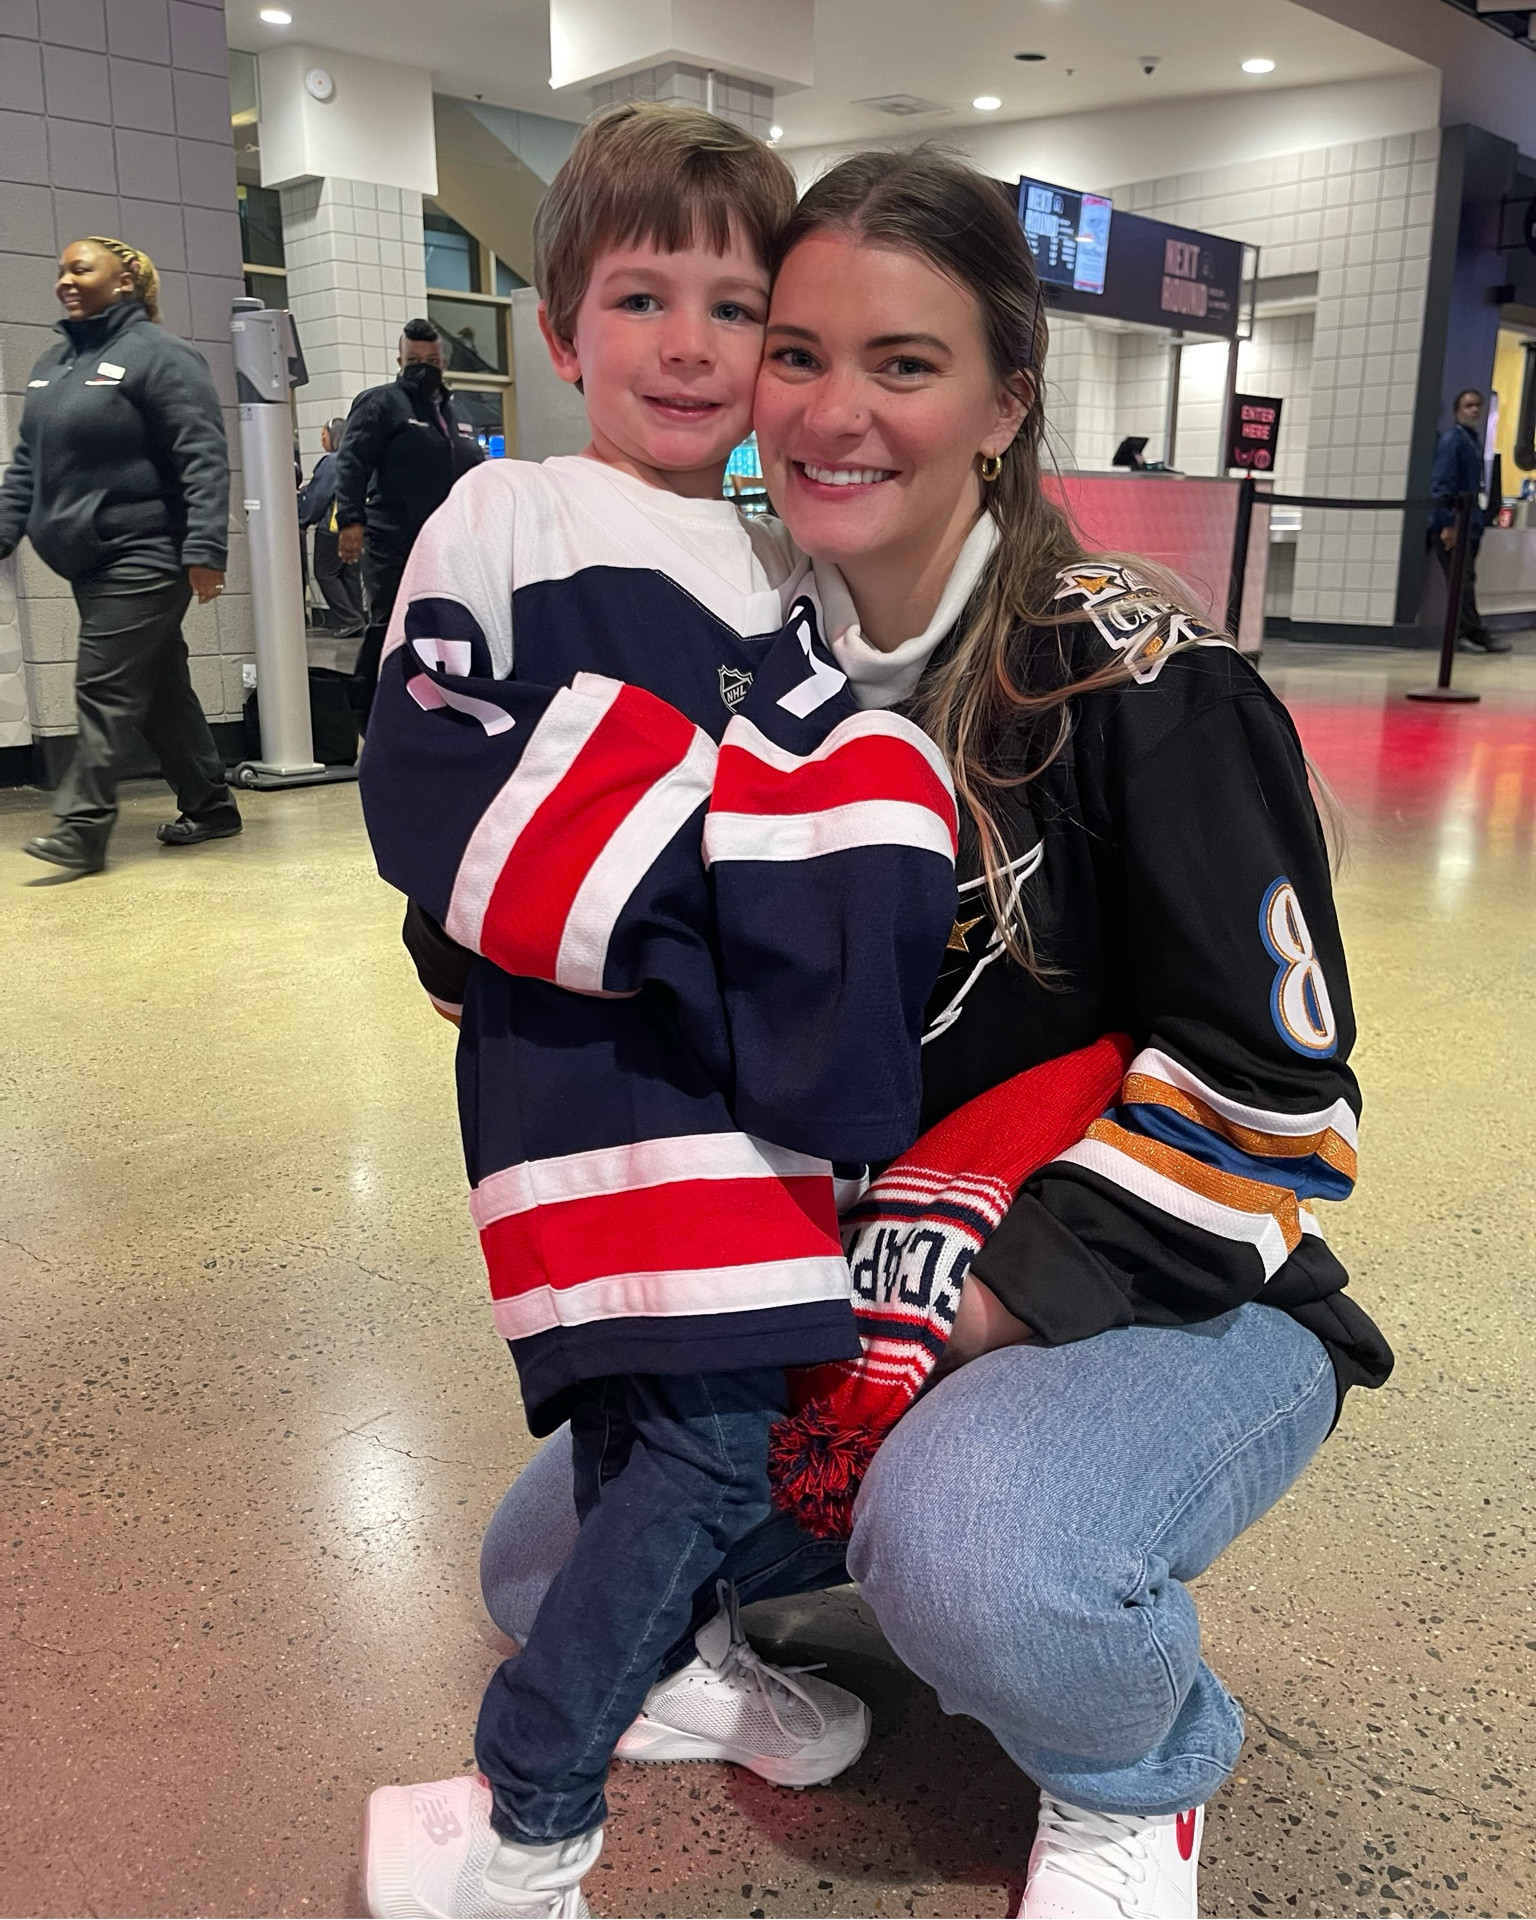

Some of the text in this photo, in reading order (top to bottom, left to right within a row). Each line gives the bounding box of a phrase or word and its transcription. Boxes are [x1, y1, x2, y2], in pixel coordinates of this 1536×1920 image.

[1240, 404, 1276, 423] ENTER
[1241, 422, 1271, 440] HERE
[726, 685, 747, 703] NHL
[1258, 875, 1339, 1060] 8
